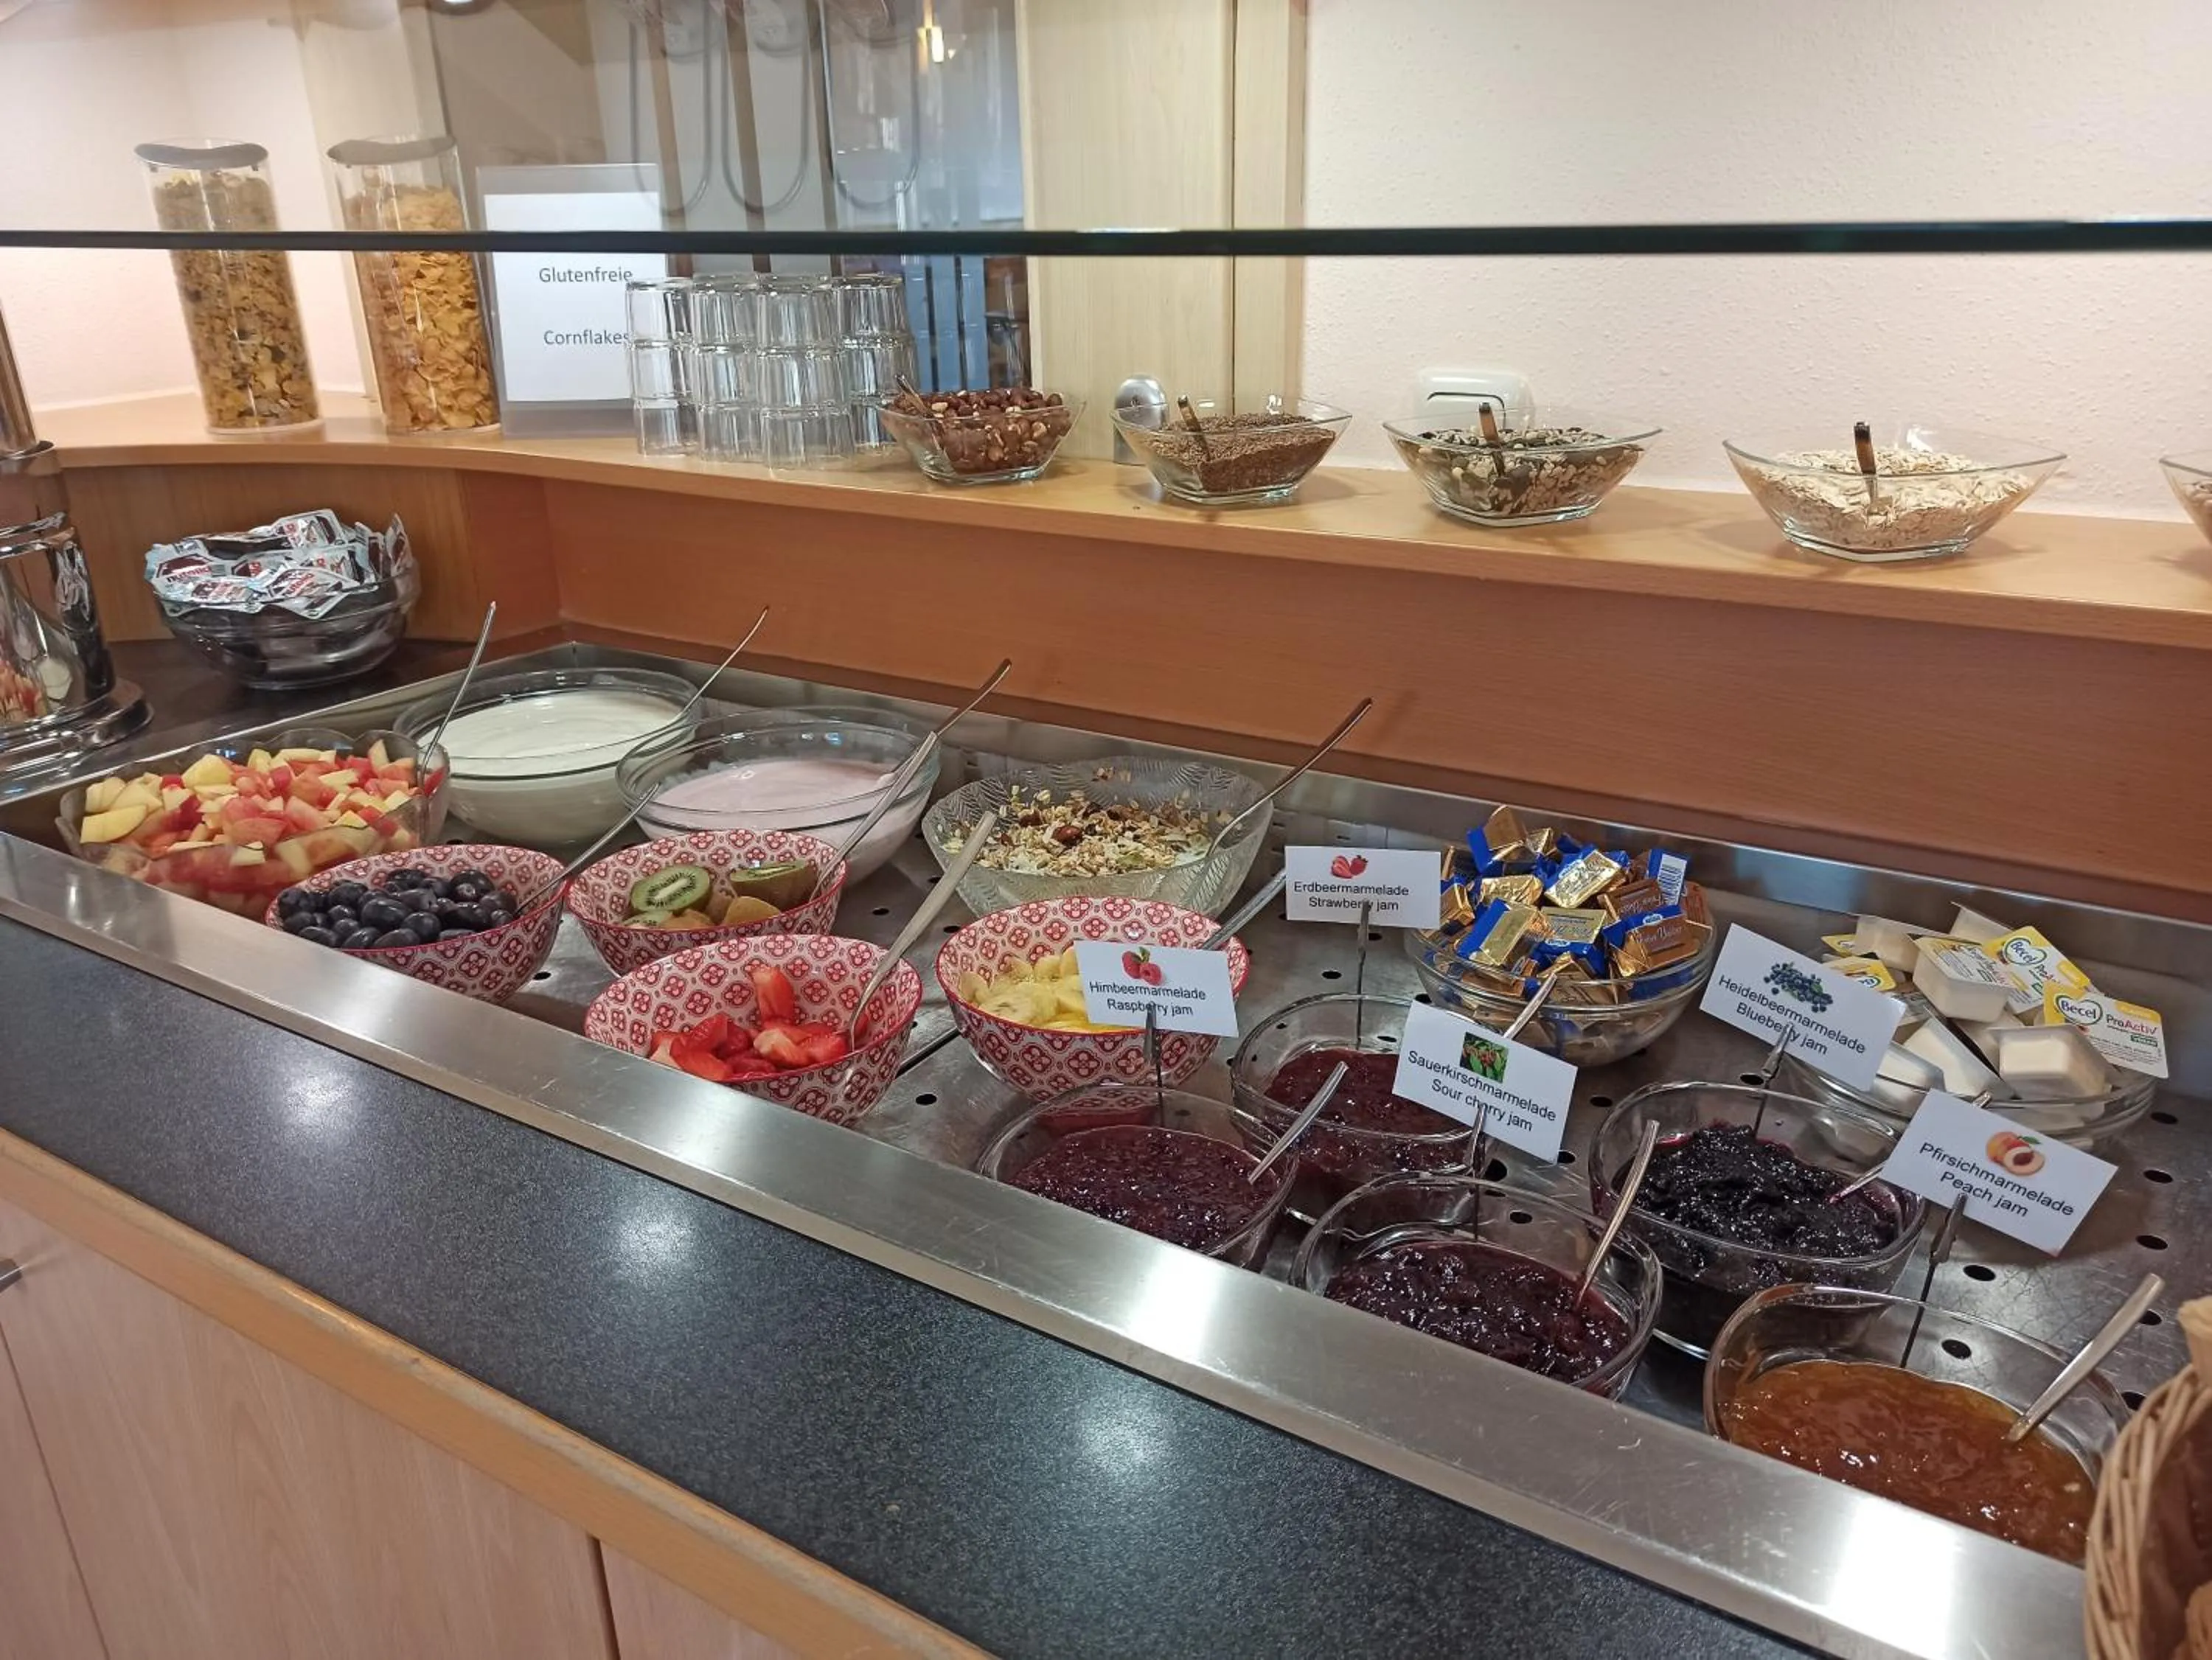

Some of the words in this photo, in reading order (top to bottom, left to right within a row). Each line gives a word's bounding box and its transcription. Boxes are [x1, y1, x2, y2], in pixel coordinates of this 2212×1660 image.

[539, 266, 633, 282] Glutenfreie
[543, 329, 630, 345] Cornflakes
[1293, 881, 1409, 896] Erdbeermarmelade
[1309, 896, 1374, 912] Strawbery
[1377, 899, 1399, 912] jam
[1089, 981, 1206, 1000] Himbeermarmelade
[1171, 1002, 1194, 1016] jam
[1719, 974, 1866, 1054] Heidelbeermarmelade
[2060, 1000, 2096, 1019] Becel
[1736, 1002, 1801, 1042] Bluebey
[1801, 1033, 1829, 1056] jam
[1408, 1050, 1557, 1121] Sauerkirschmarmelade
[1431, 1078, 1463, 1101] Sour
[1465, 1095, 1506, 1120] chrry
[1506, 1110, 1533, 1131] jam
[1919, 1142, 2074, 1216] Pfirsichmarmelade
[1940, 1171, 1993, 1202] Peach
[1993, 1193, 2028, 1218] jam
